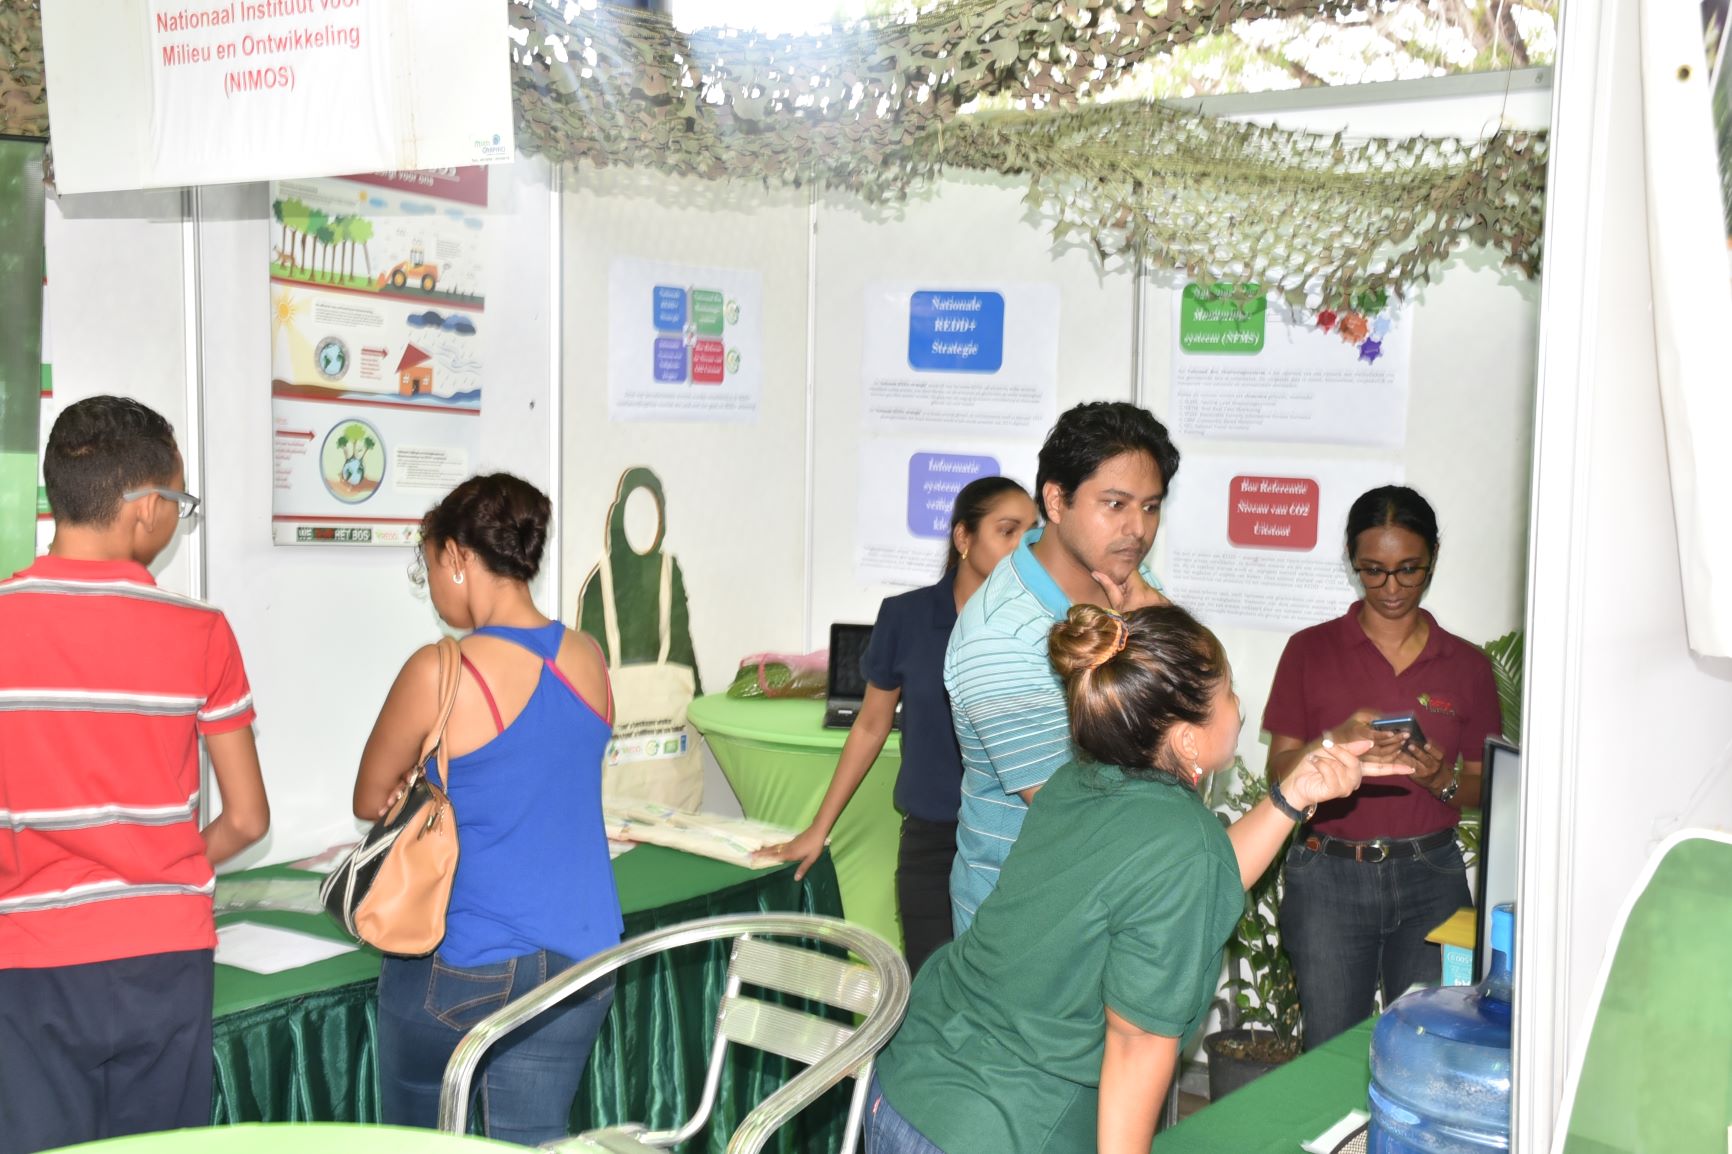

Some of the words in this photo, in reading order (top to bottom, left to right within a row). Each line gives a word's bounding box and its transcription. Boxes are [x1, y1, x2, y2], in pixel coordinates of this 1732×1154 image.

[156, 7, 235, 33] Nationaal
[162, 43, 211, 67] Milieu
[216, 42, 236, 61] en
[242, 24, 360, 57] Ontwikkeling
[224, 64, 296, 98] (NIMOS)
[931, 295, 982, 312] Nationale
[934, 318, 977, 333] REDD+
[1221, 330, 1260, 347] (NFMS)
[931, 340, 979, 358] Strategie
[928, 458, 980, 475] Informatie
[1240, 479, 1258, 493] Bos
[1259, 480, 1307, 495] Referentie
[1237, 501, 1269, 515] Niveau
[1270, 503, 1287, 516] van
[1289, 502, 1310, 517] CO2
[352, 530, 370, 541] BOS
[1253, 522, 1291, 537] Uitstoot
